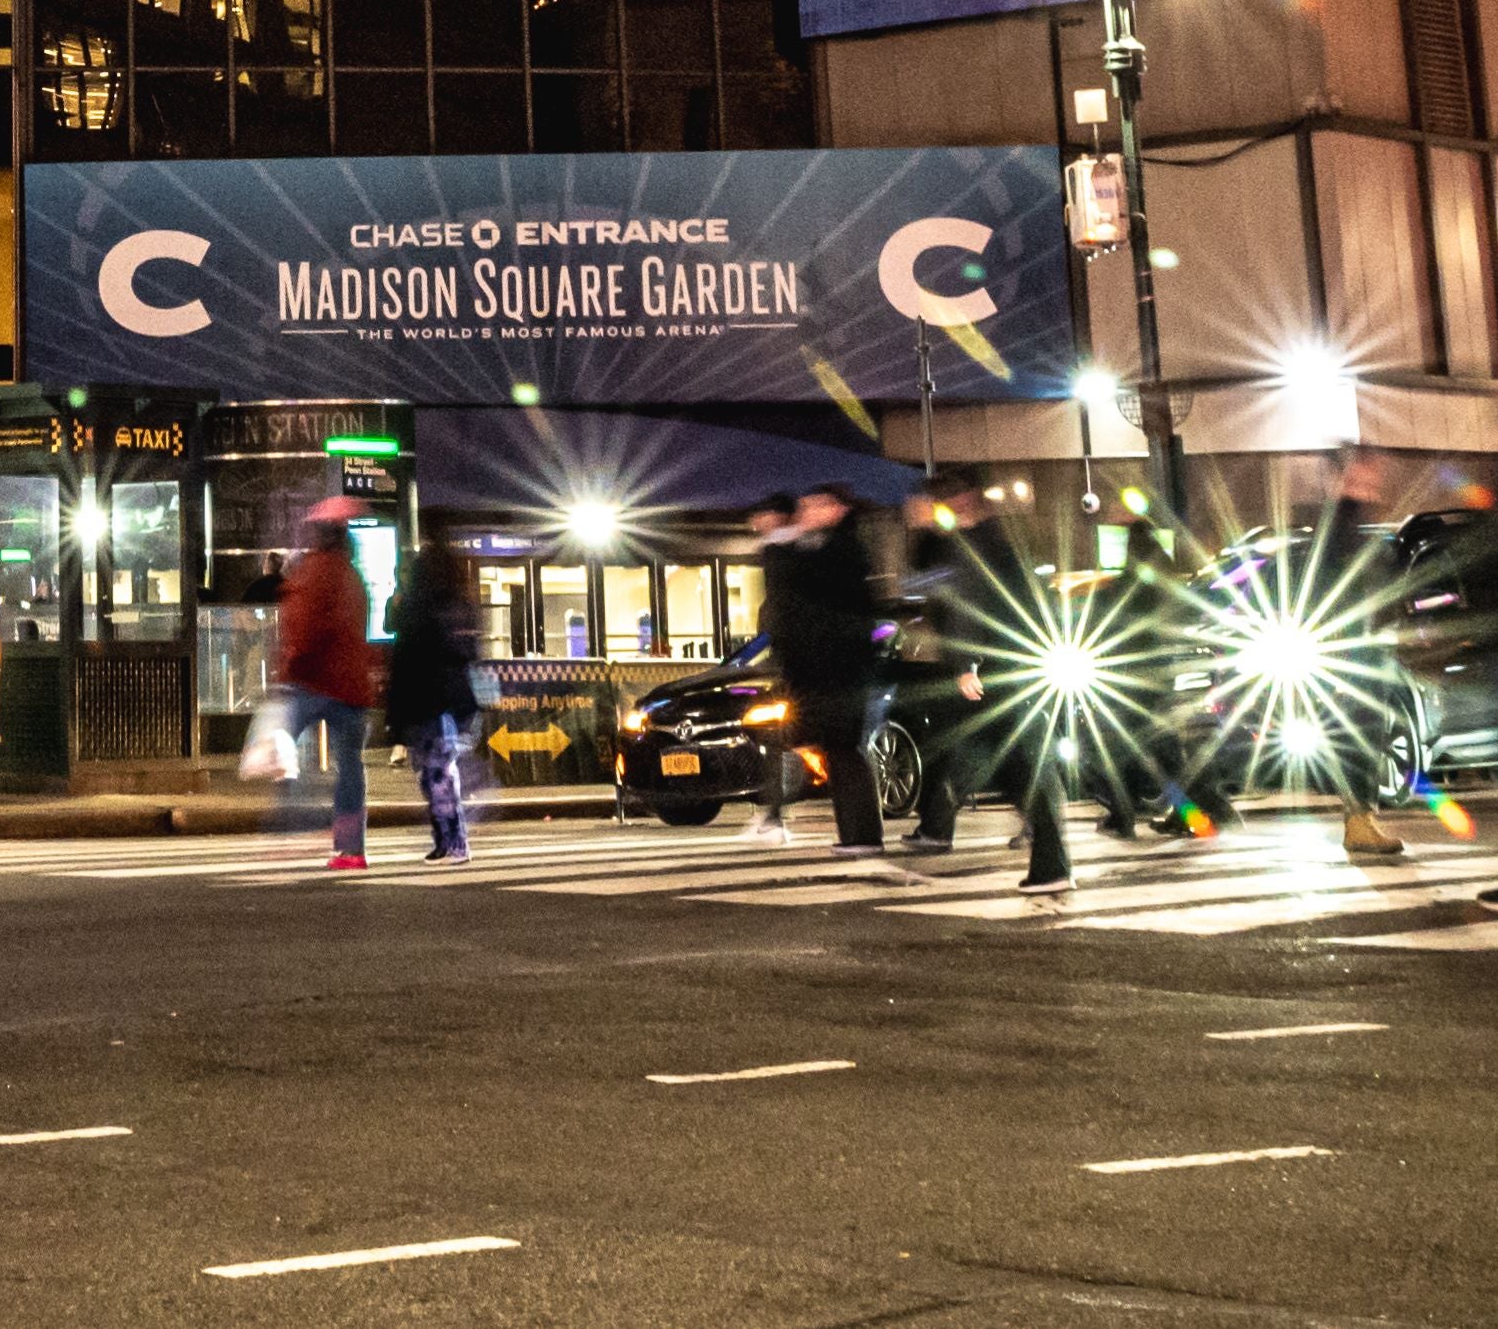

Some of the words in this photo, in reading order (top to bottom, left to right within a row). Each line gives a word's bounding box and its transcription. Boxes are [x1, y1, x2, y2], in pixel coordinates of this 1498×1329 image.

[350, 223, 465, 249] CHASE
[515, 218, 729, 246] ENTRANCE
[98, 229, 212, 336] C
[878, 217, 998, 327] C
[277, 260, 458, 321] MADISON
[472, 256, 626, 323] SQUARE
[640, 254, 799, 316] GARDEN
[356, 328, 395, 340] THE
[403, 327, 492, 339] WORLD'S
[501, 326, 556, 339] MOST
[565, 325, 647, 338] FAMOUS
[133, 428, 170, 449] TAXI
[542, 695, 595, 712] Anytime
